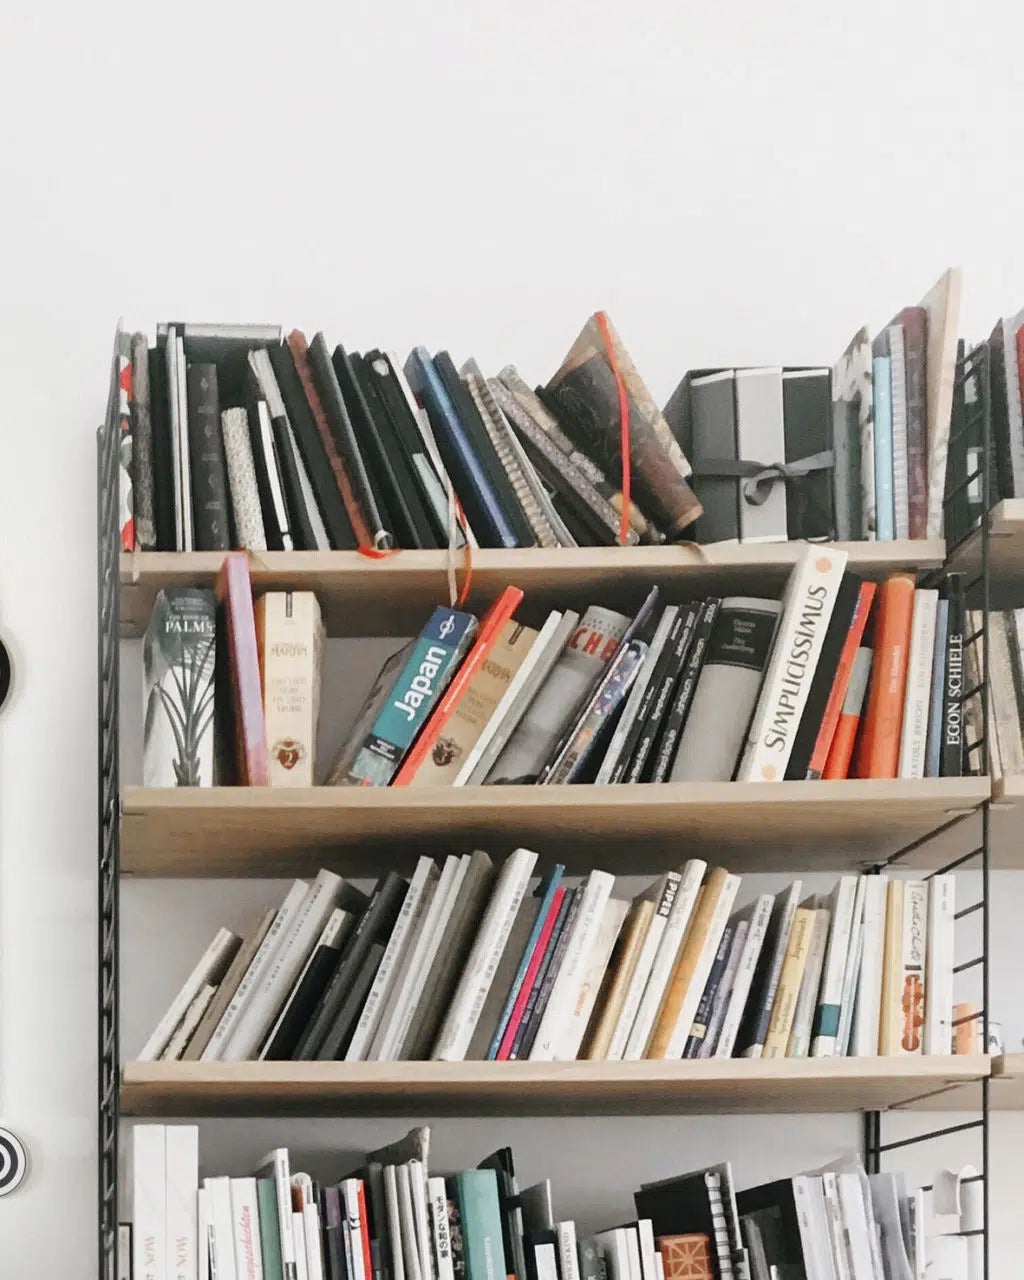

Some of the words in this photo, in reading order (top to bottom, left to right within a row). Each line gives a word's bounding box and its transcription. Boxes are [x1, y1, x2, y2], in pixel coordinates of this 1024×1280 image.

[165, 620, 215, 632] PALMS
[393, 645, 447, 721] Japan
[948, 633, 963, 698] SCHIELE
[946, 703, 961, 747] EGON
[657, 880, 680, 917] PIPER
